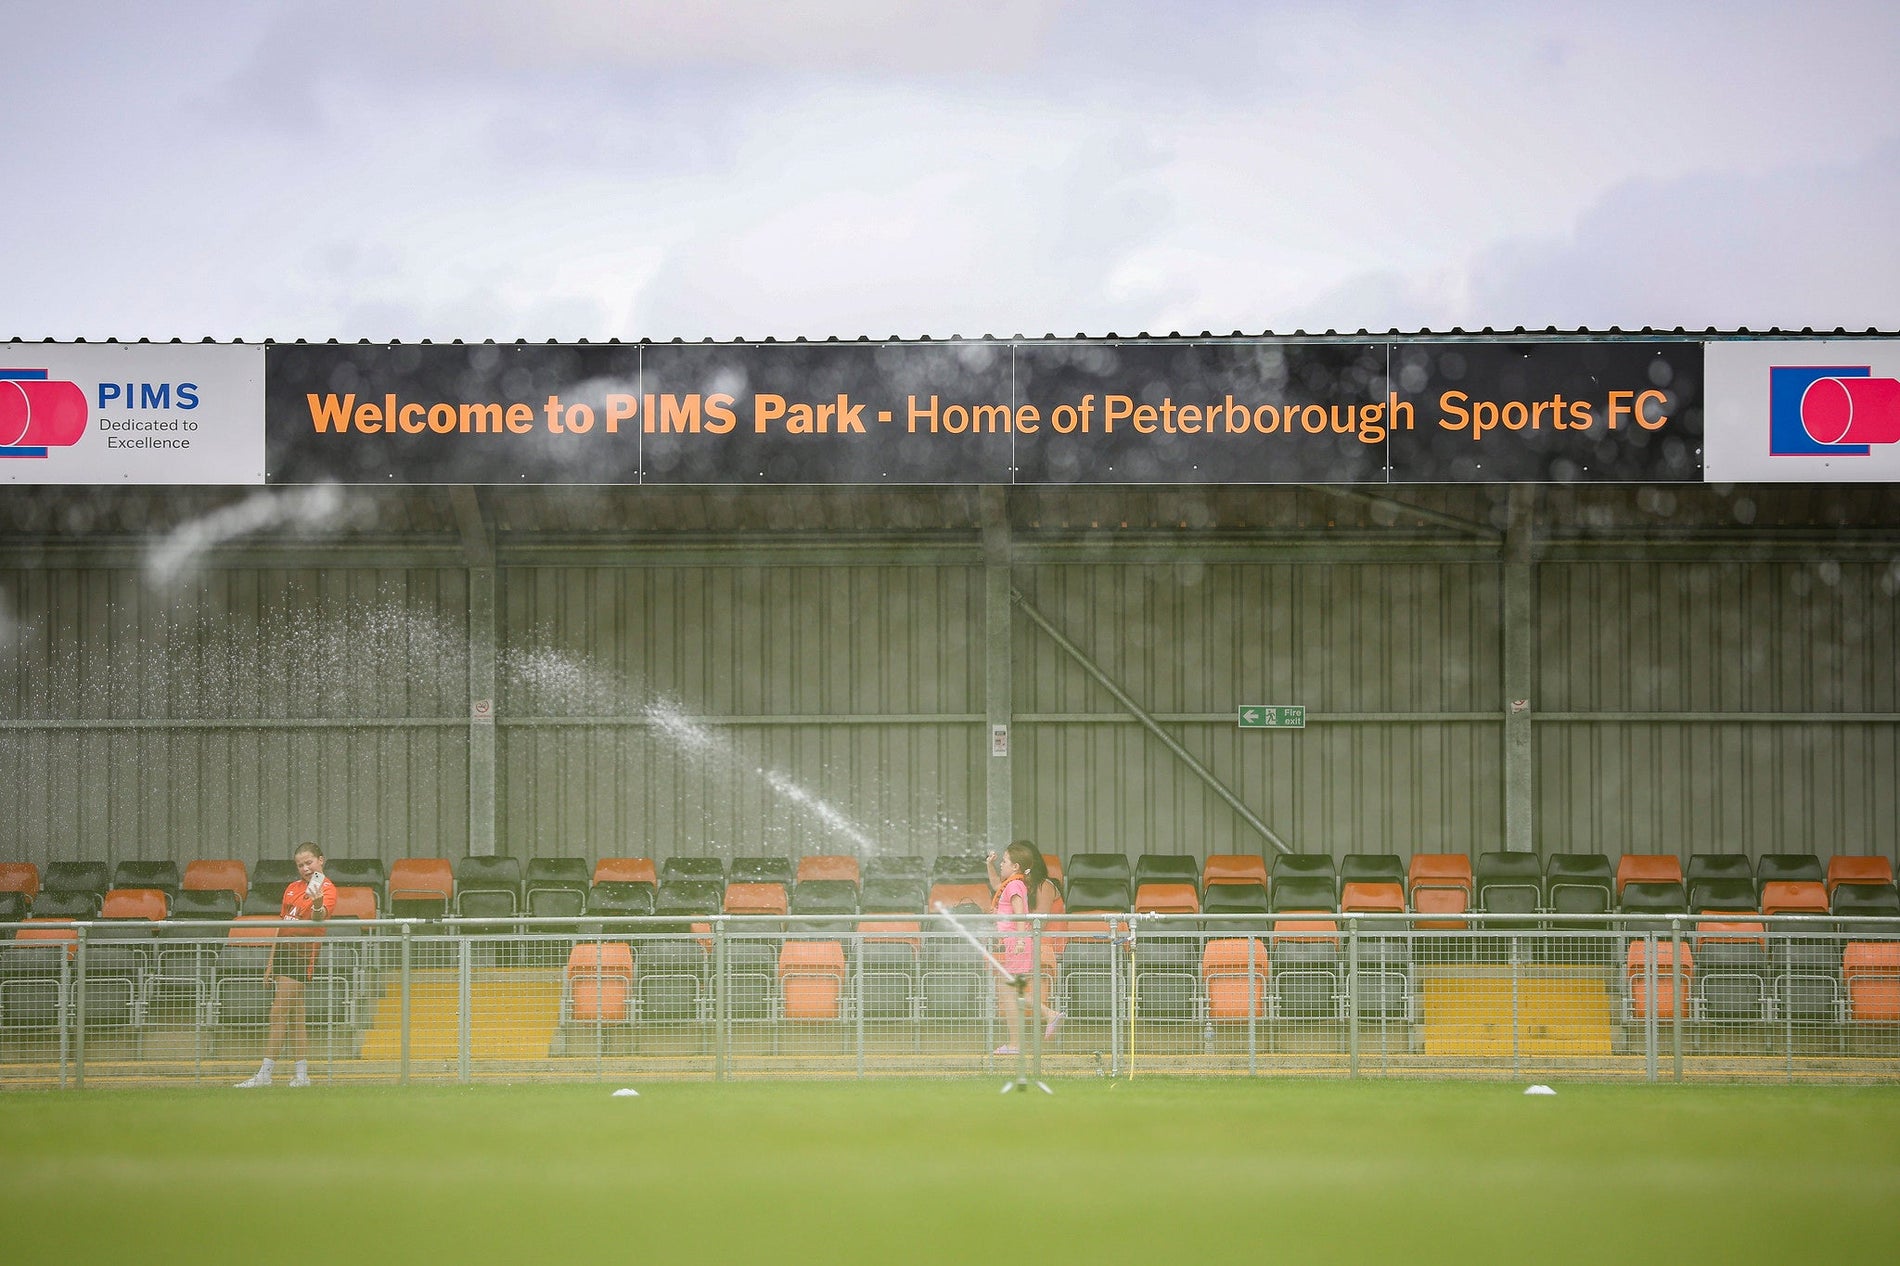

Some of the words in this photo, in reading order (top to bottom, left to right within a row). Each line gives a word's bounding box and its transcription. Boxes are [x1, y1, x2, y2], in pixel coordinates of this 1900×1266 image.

[98, 382, 200, 410] PIMS
[307, 392, 534, 435] Welcome
[543, 395, 595, 434] to
[606, 393, 737, 434] PIMS
[754, 393, 866, 434] Park
[877, 410, 892, 423] -
[907, 394, 1041, 434] Home
[1051, 394, 1095, 434] of
[1104, 392, 1415, 445] Peterborough
[1438, 389, 1594, 441] Sports
[1607, 389, 1668, 431] FC
[99, 418, 178, 432] Dedicated
[182, 419, 199, 432] to
[107, 436, 190, 449] Excellence
[1284, 708, 1302, 717] Fire
[1284, 717, 1302, 725] exit
